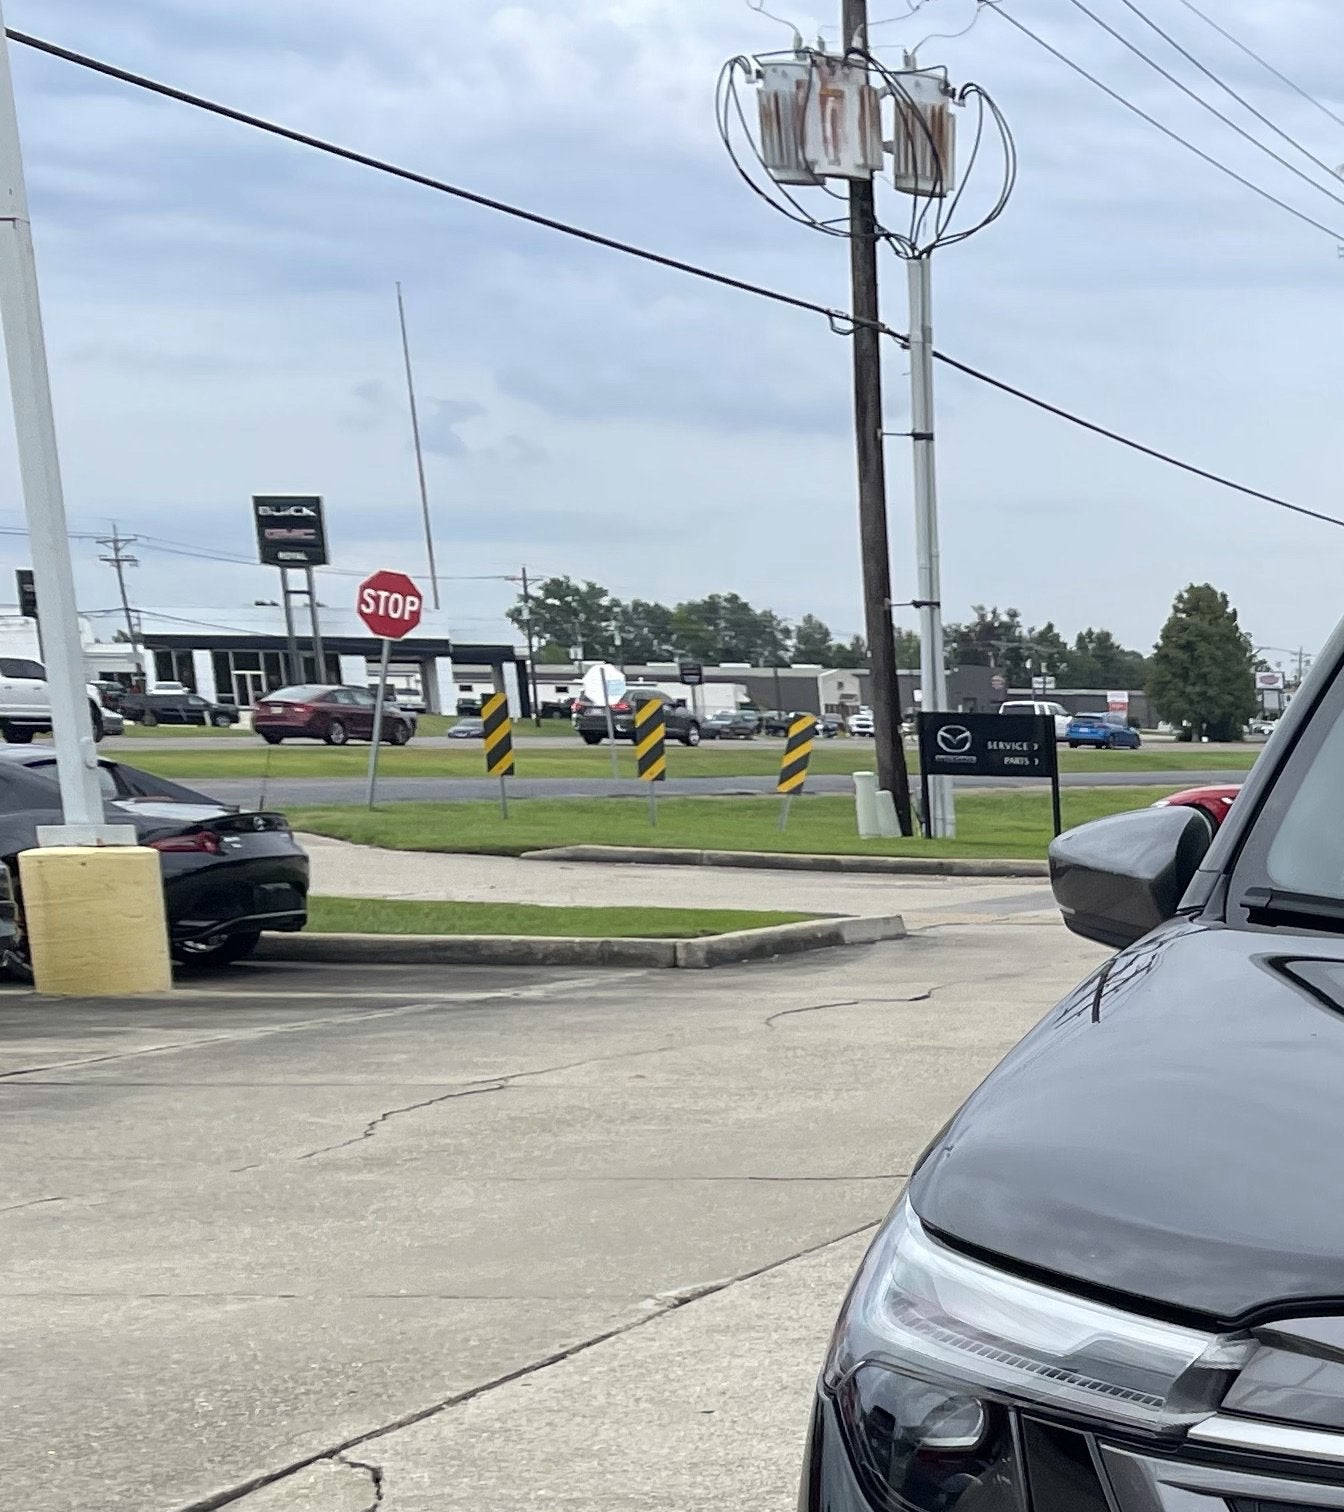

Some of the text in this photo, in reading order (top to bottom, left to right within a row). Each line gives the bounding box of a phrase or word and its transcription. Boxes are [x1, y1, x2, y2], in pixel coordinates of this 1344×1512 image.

[361, 588, 419, 620] STOP
[987, 740, 1029, 751] SERVICE
[1003, 756, 1030, 766] PARTS
